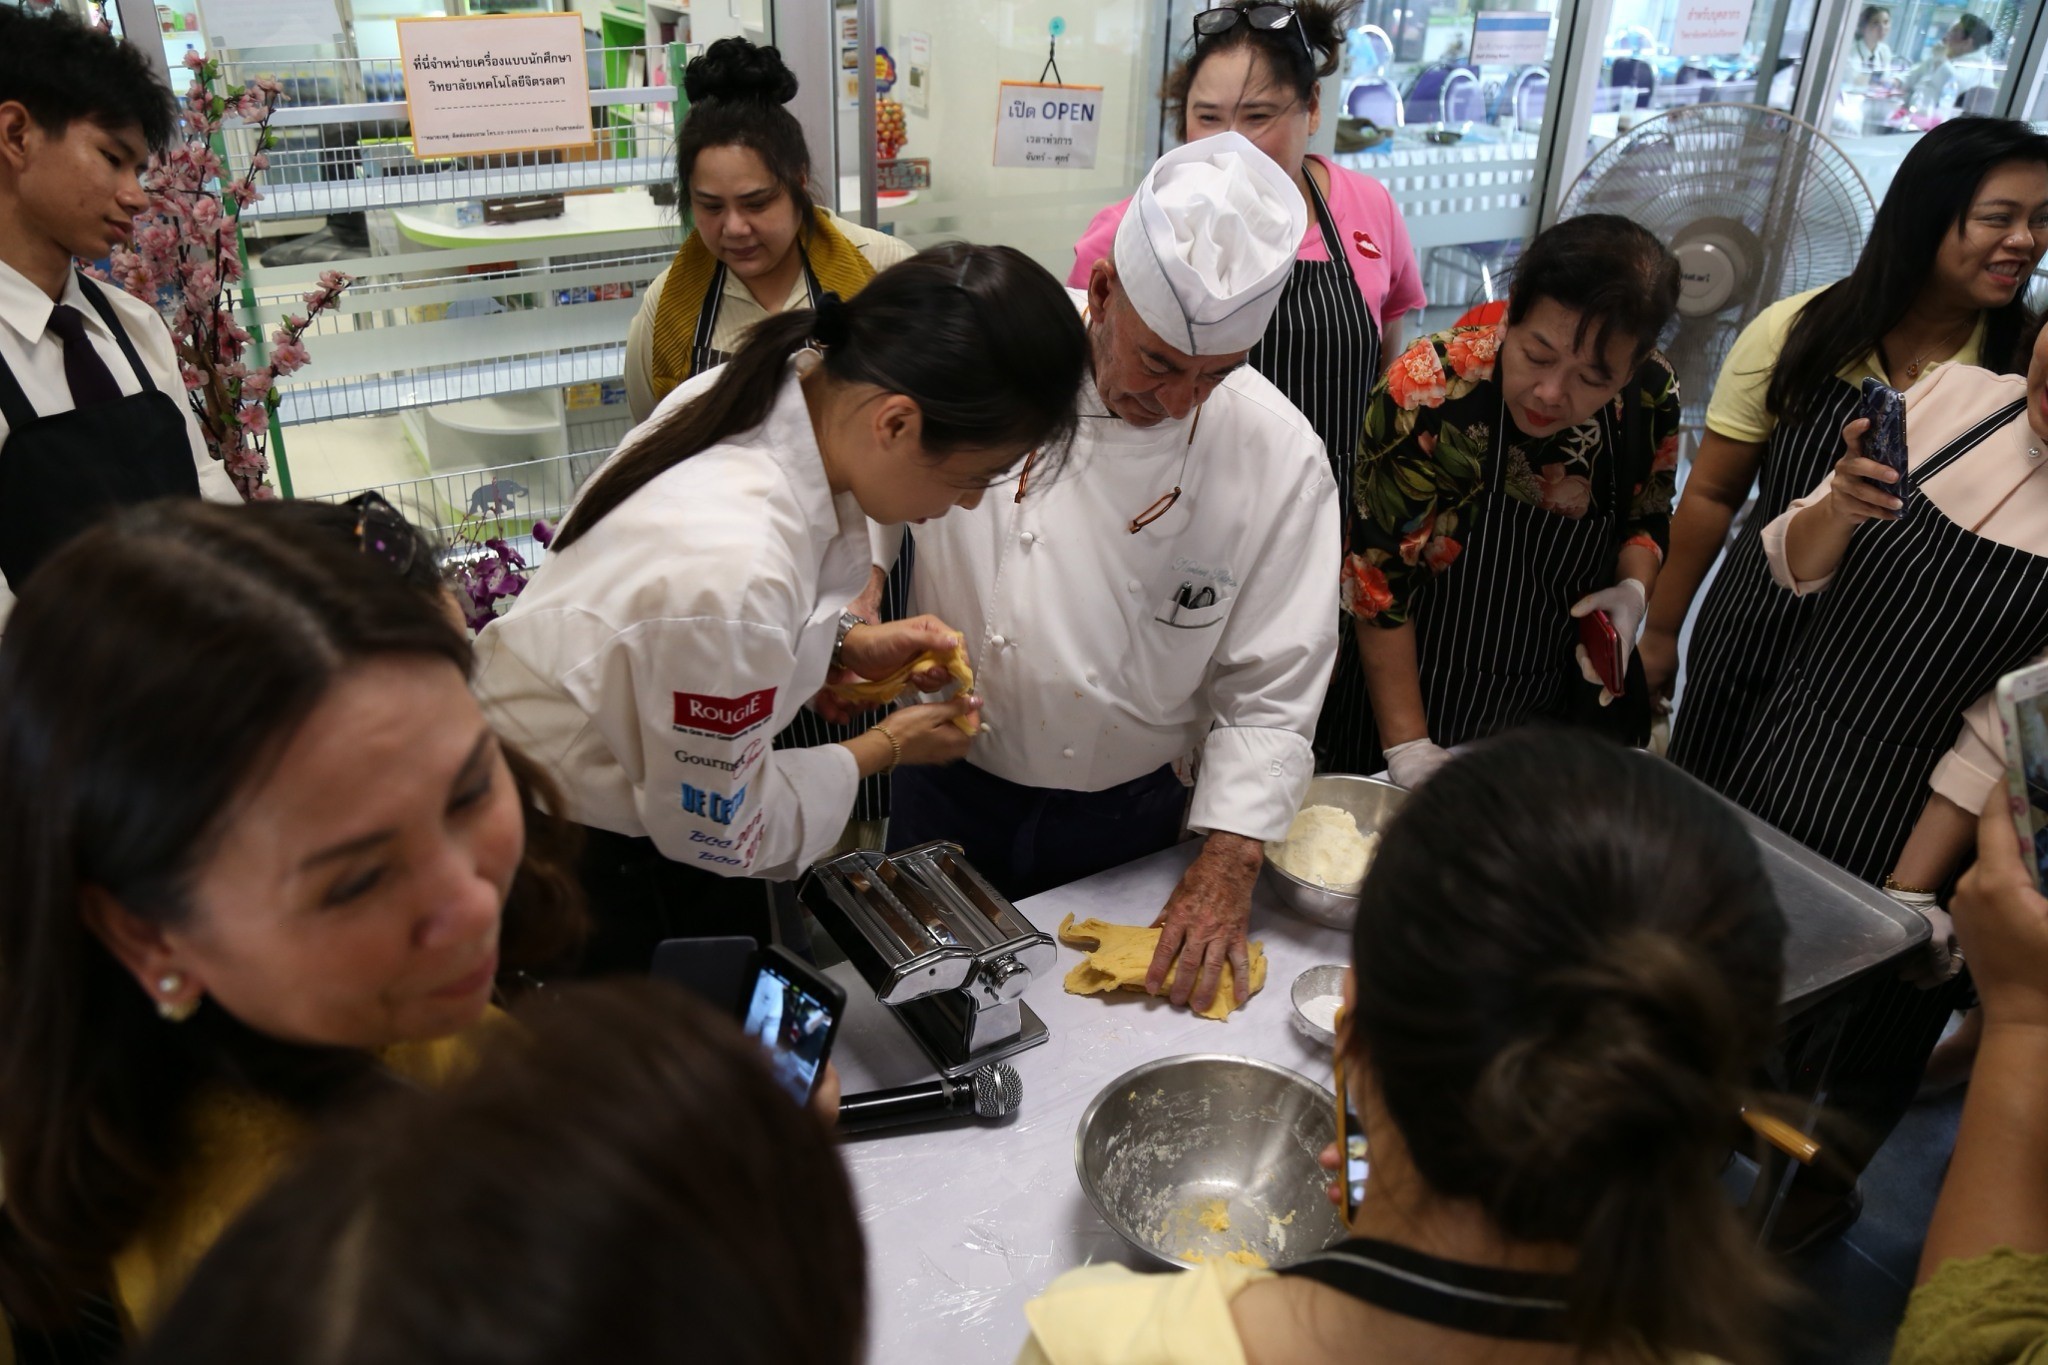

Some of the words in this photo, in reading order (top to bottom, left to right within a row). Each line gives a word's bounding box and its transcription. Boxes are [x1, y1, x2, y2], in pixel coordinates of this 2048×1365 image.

[413, 51, 572, 70] ที่นี่จำหน่ายเครื่องแบบนักศึกษา
[429, 75, 566, 93] วิทยาลัยเทคโนโลยีจิตรลดา
[1008, 100, 1036, 119] เปิด
[1042, 101, 1095, 121] OPEN
[1026, 133, 1073, 146] เวลาทำการ
